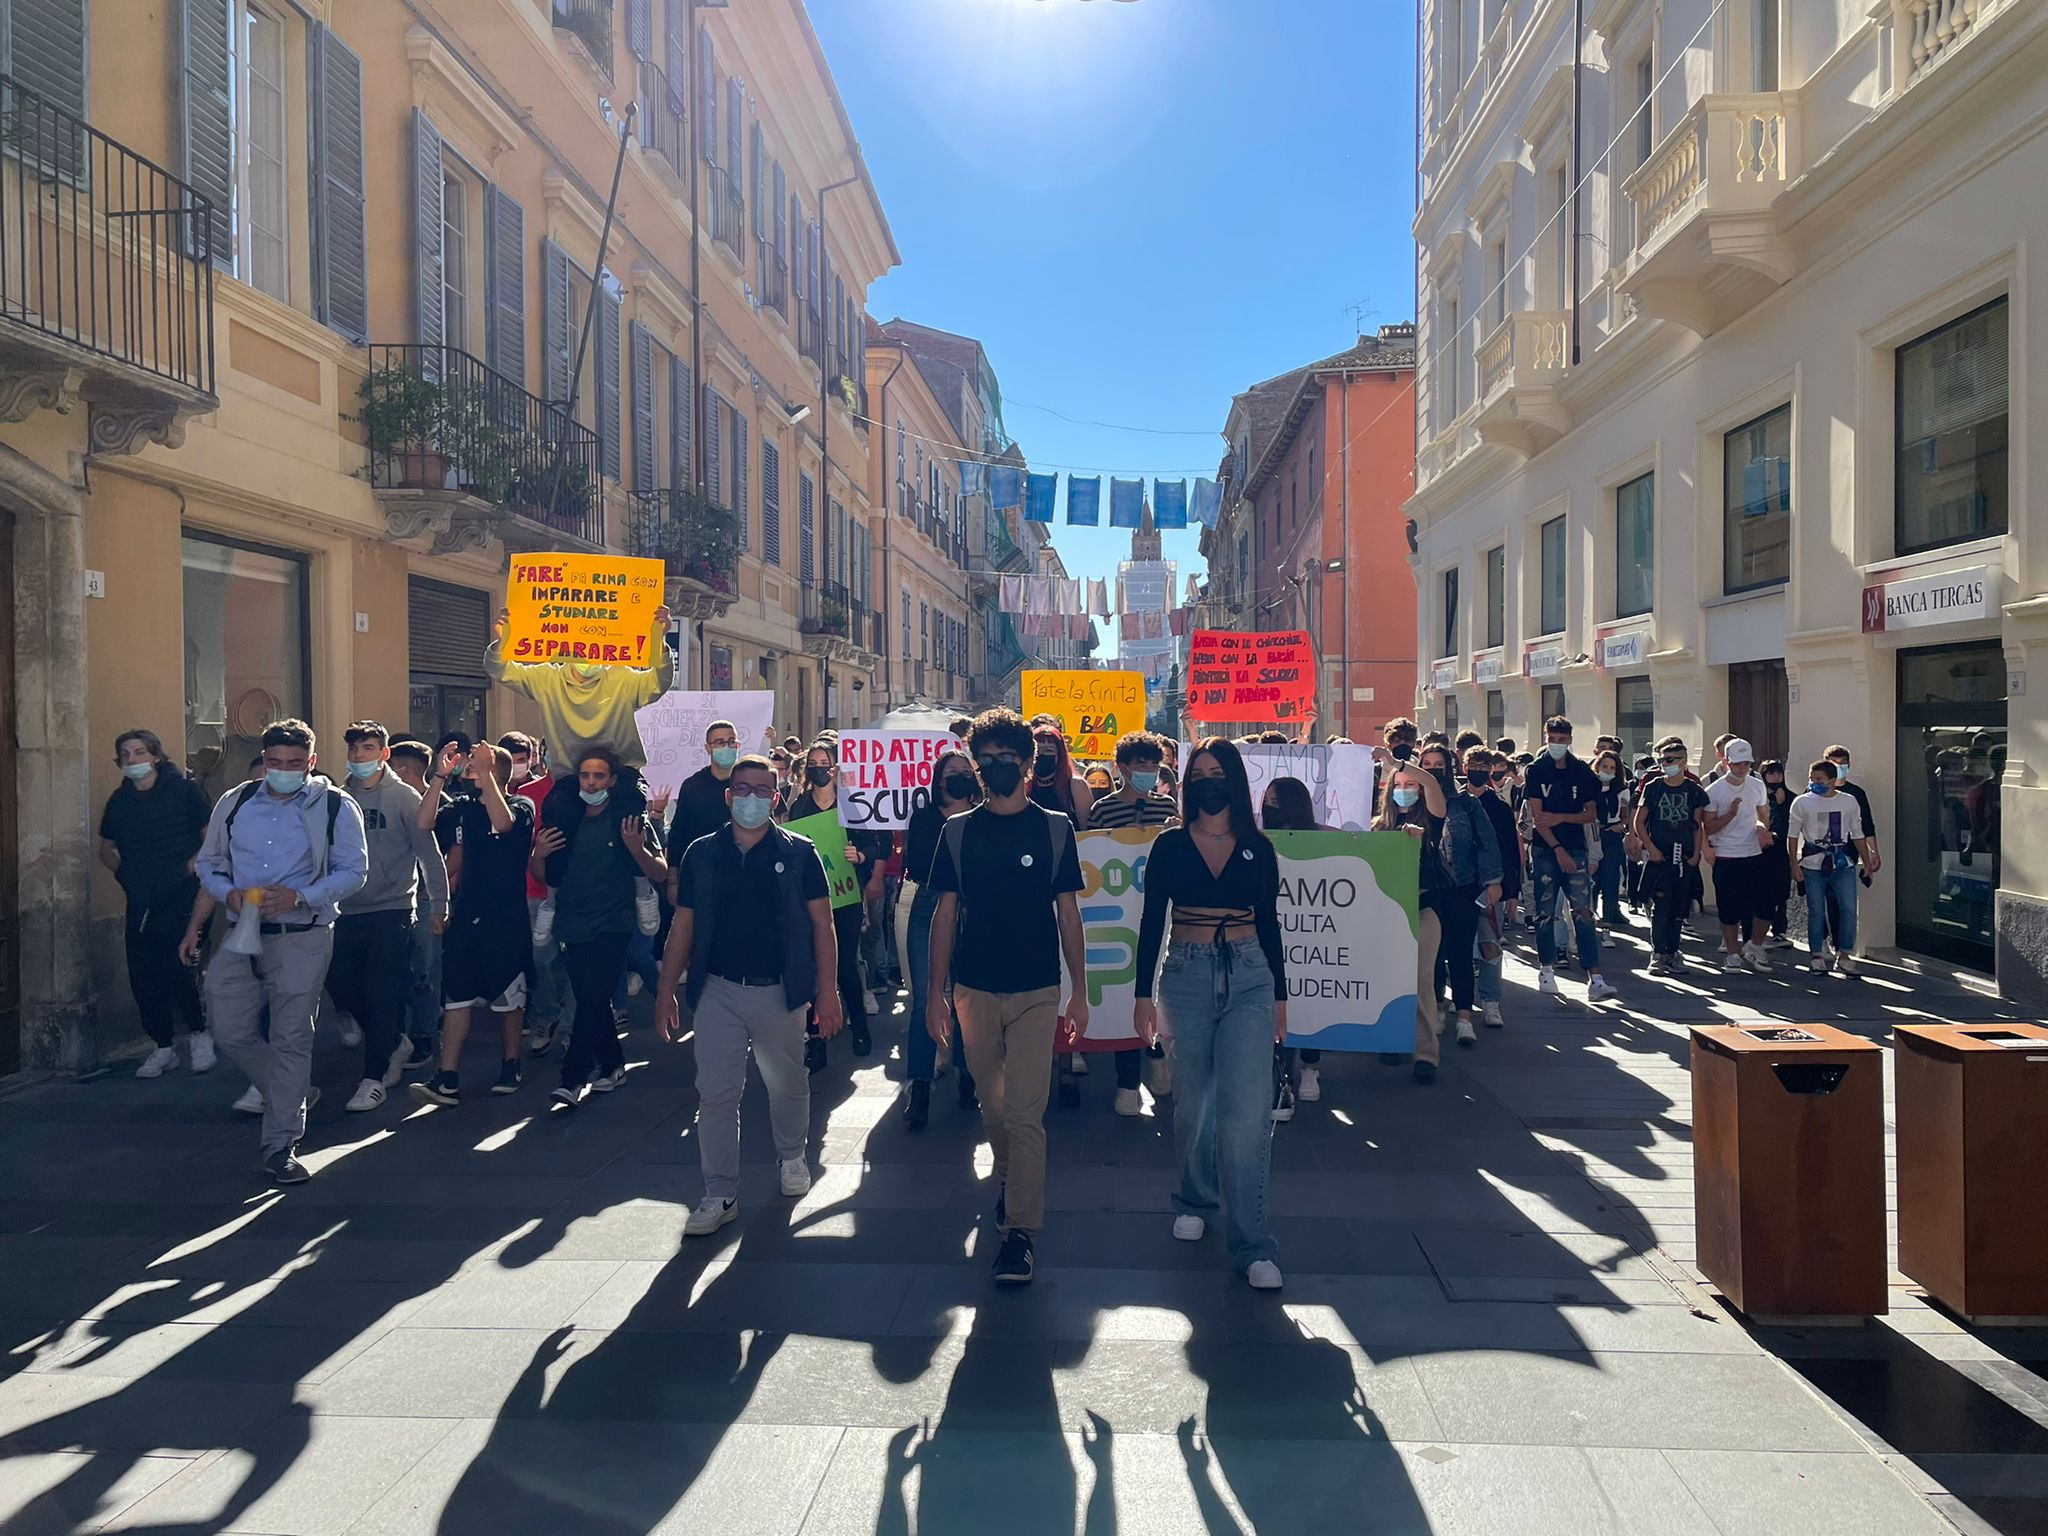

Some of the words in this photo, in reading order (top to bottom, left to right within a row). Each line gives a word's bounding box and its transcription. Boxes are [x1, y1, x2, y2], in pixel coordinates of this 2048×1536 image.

[571, 573, 587, 584] FA
[592, 572, 626, 586] RIMA
[631, 576, 657, 588] CON
[532, 586, 618, 602] IMPARARE
[1886, 591, 1927, 616] BANCA
[1931, 581, 1983, 610] TERCAS
[539, 603, 619, 620] STUDIARE
[541, 622, 569, 633] NON
[1221, 638, 1239, 648] CON
[1241, 638, 1250, 649] LE
[1220, 653, 1239, 664] CON
[1246, 653, 1257, 665] LA
[1235, 670, 1249, 683] LA
[1256, 668, 1299, 684] SCUOLA
[701, 692, 716, 708] SI
[1190, 690, 1198, 704] O
[1204, 688, 1227, 705] NON
[1073, 704, 1096, 713] con
[1080, 712, 1118, 736] BLA
[1247, 744, 1327, 784] SIAMO
[859, 764, 888, 789] LA
[1658, 792, 1689, 807] ADI
[1659, 806, 1689, 821] DAS
[1277, 877, 1356, 907] AMO
[1285, 977, 1369, 1000] UDENTI
